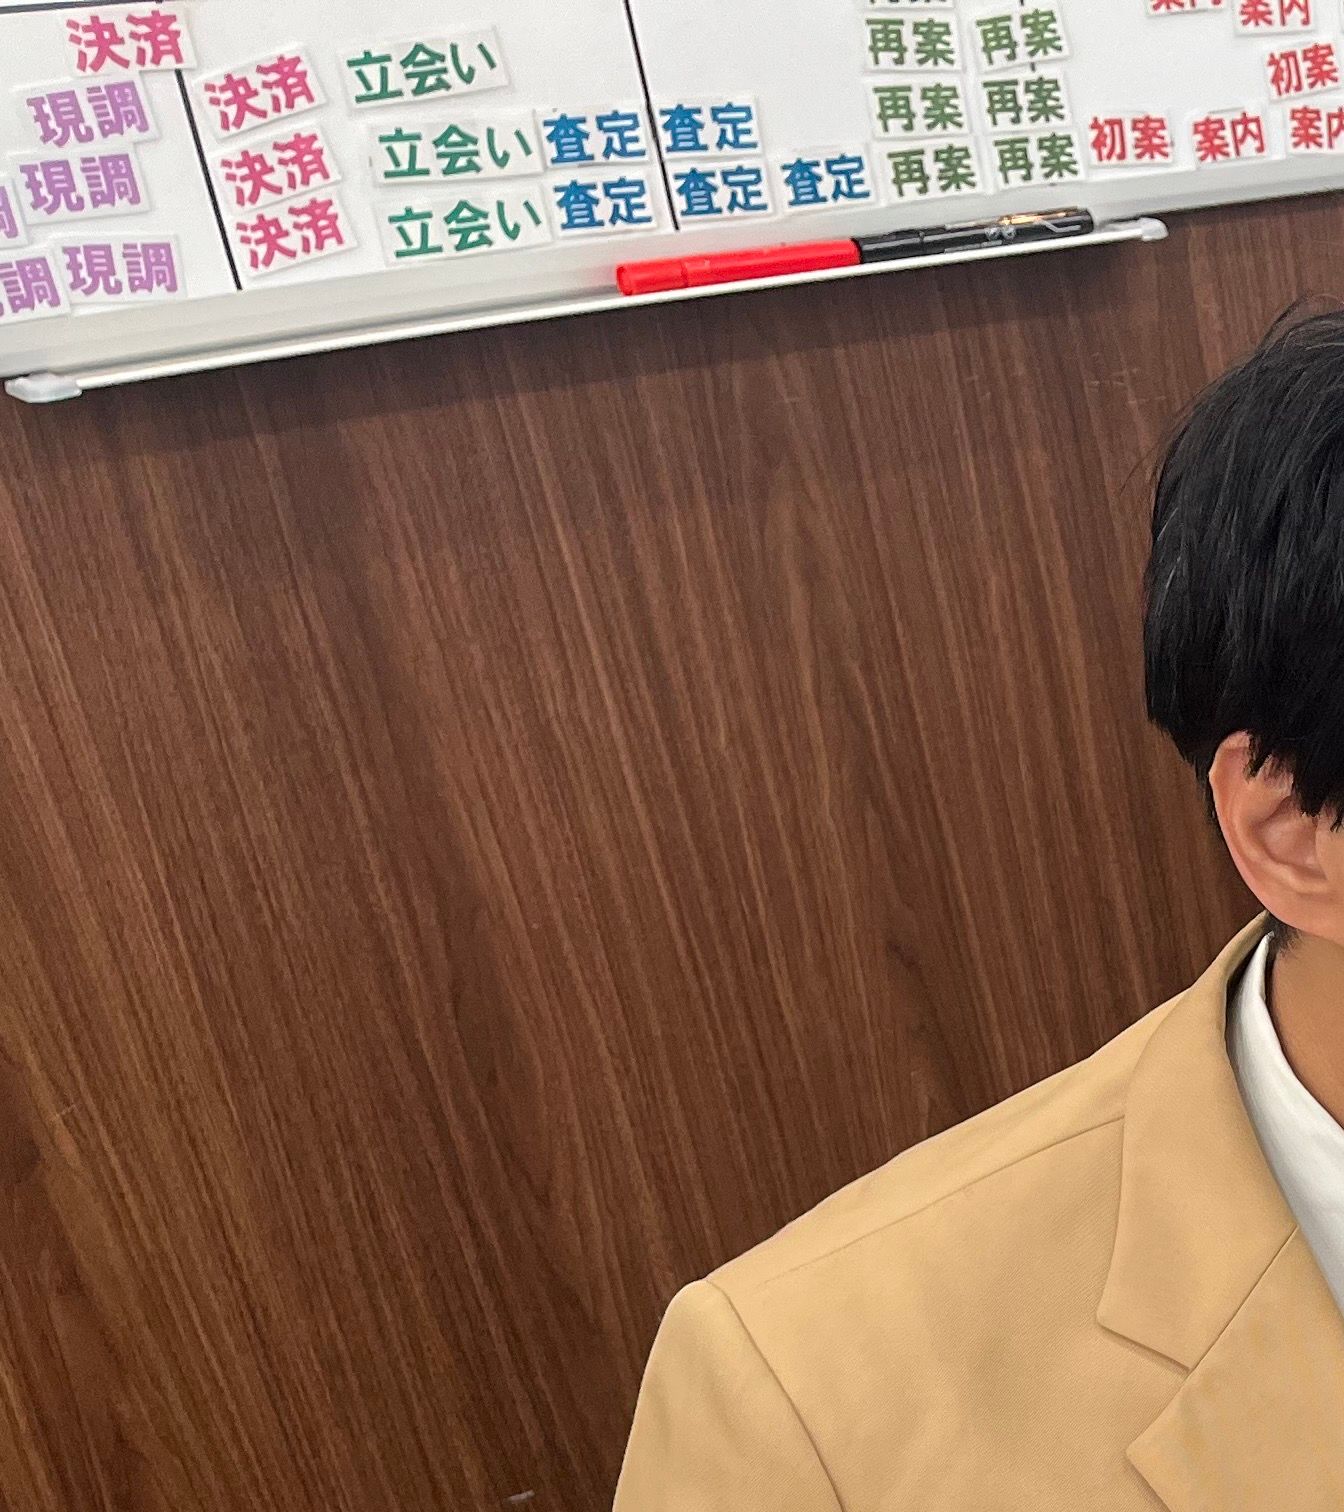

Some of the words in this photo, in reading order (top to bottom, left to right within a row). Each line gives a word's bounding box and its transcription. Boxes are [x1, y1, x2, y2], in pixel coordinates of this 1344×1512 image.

[66, 10, 182, 73] 決済
[865, 17, 955, 67] 再案
[976, 8, 1064, 65] 再案
[205, 55, 315, 131] 決済
[347, 41, 498, 103] 立会い
[1268, 43, 1339, 97] 初案
[26, 81, 149, 148] 現調
[660, 102, 757, 154] 査定
[875, 82, 964, 133] 再案
[982, 76, 1065, 127] 再案
[378, 124, 531, 181] 立会い
[544, 109, 643, 165] 査定
[993, 132, 1079, 183] 再案
[1089, 114, 1172, 163] 初案
[1192, 111, 1266, 162] 案内
[20, 154, 141, 215] 現調
[225, 132, 333, 208] 決済
[676, 165, 768, 218] 査定
[781, 153, 871, 207] 査定
[887, 143, 978, 196] 再案
[388, 199, 542, 258] 立会い
[555, 177, 652, 232] 査定
[239, 197, 347, 269] 決済
[0, 256, 61, 319] 調
[62, 243, 178, 296] 現調
